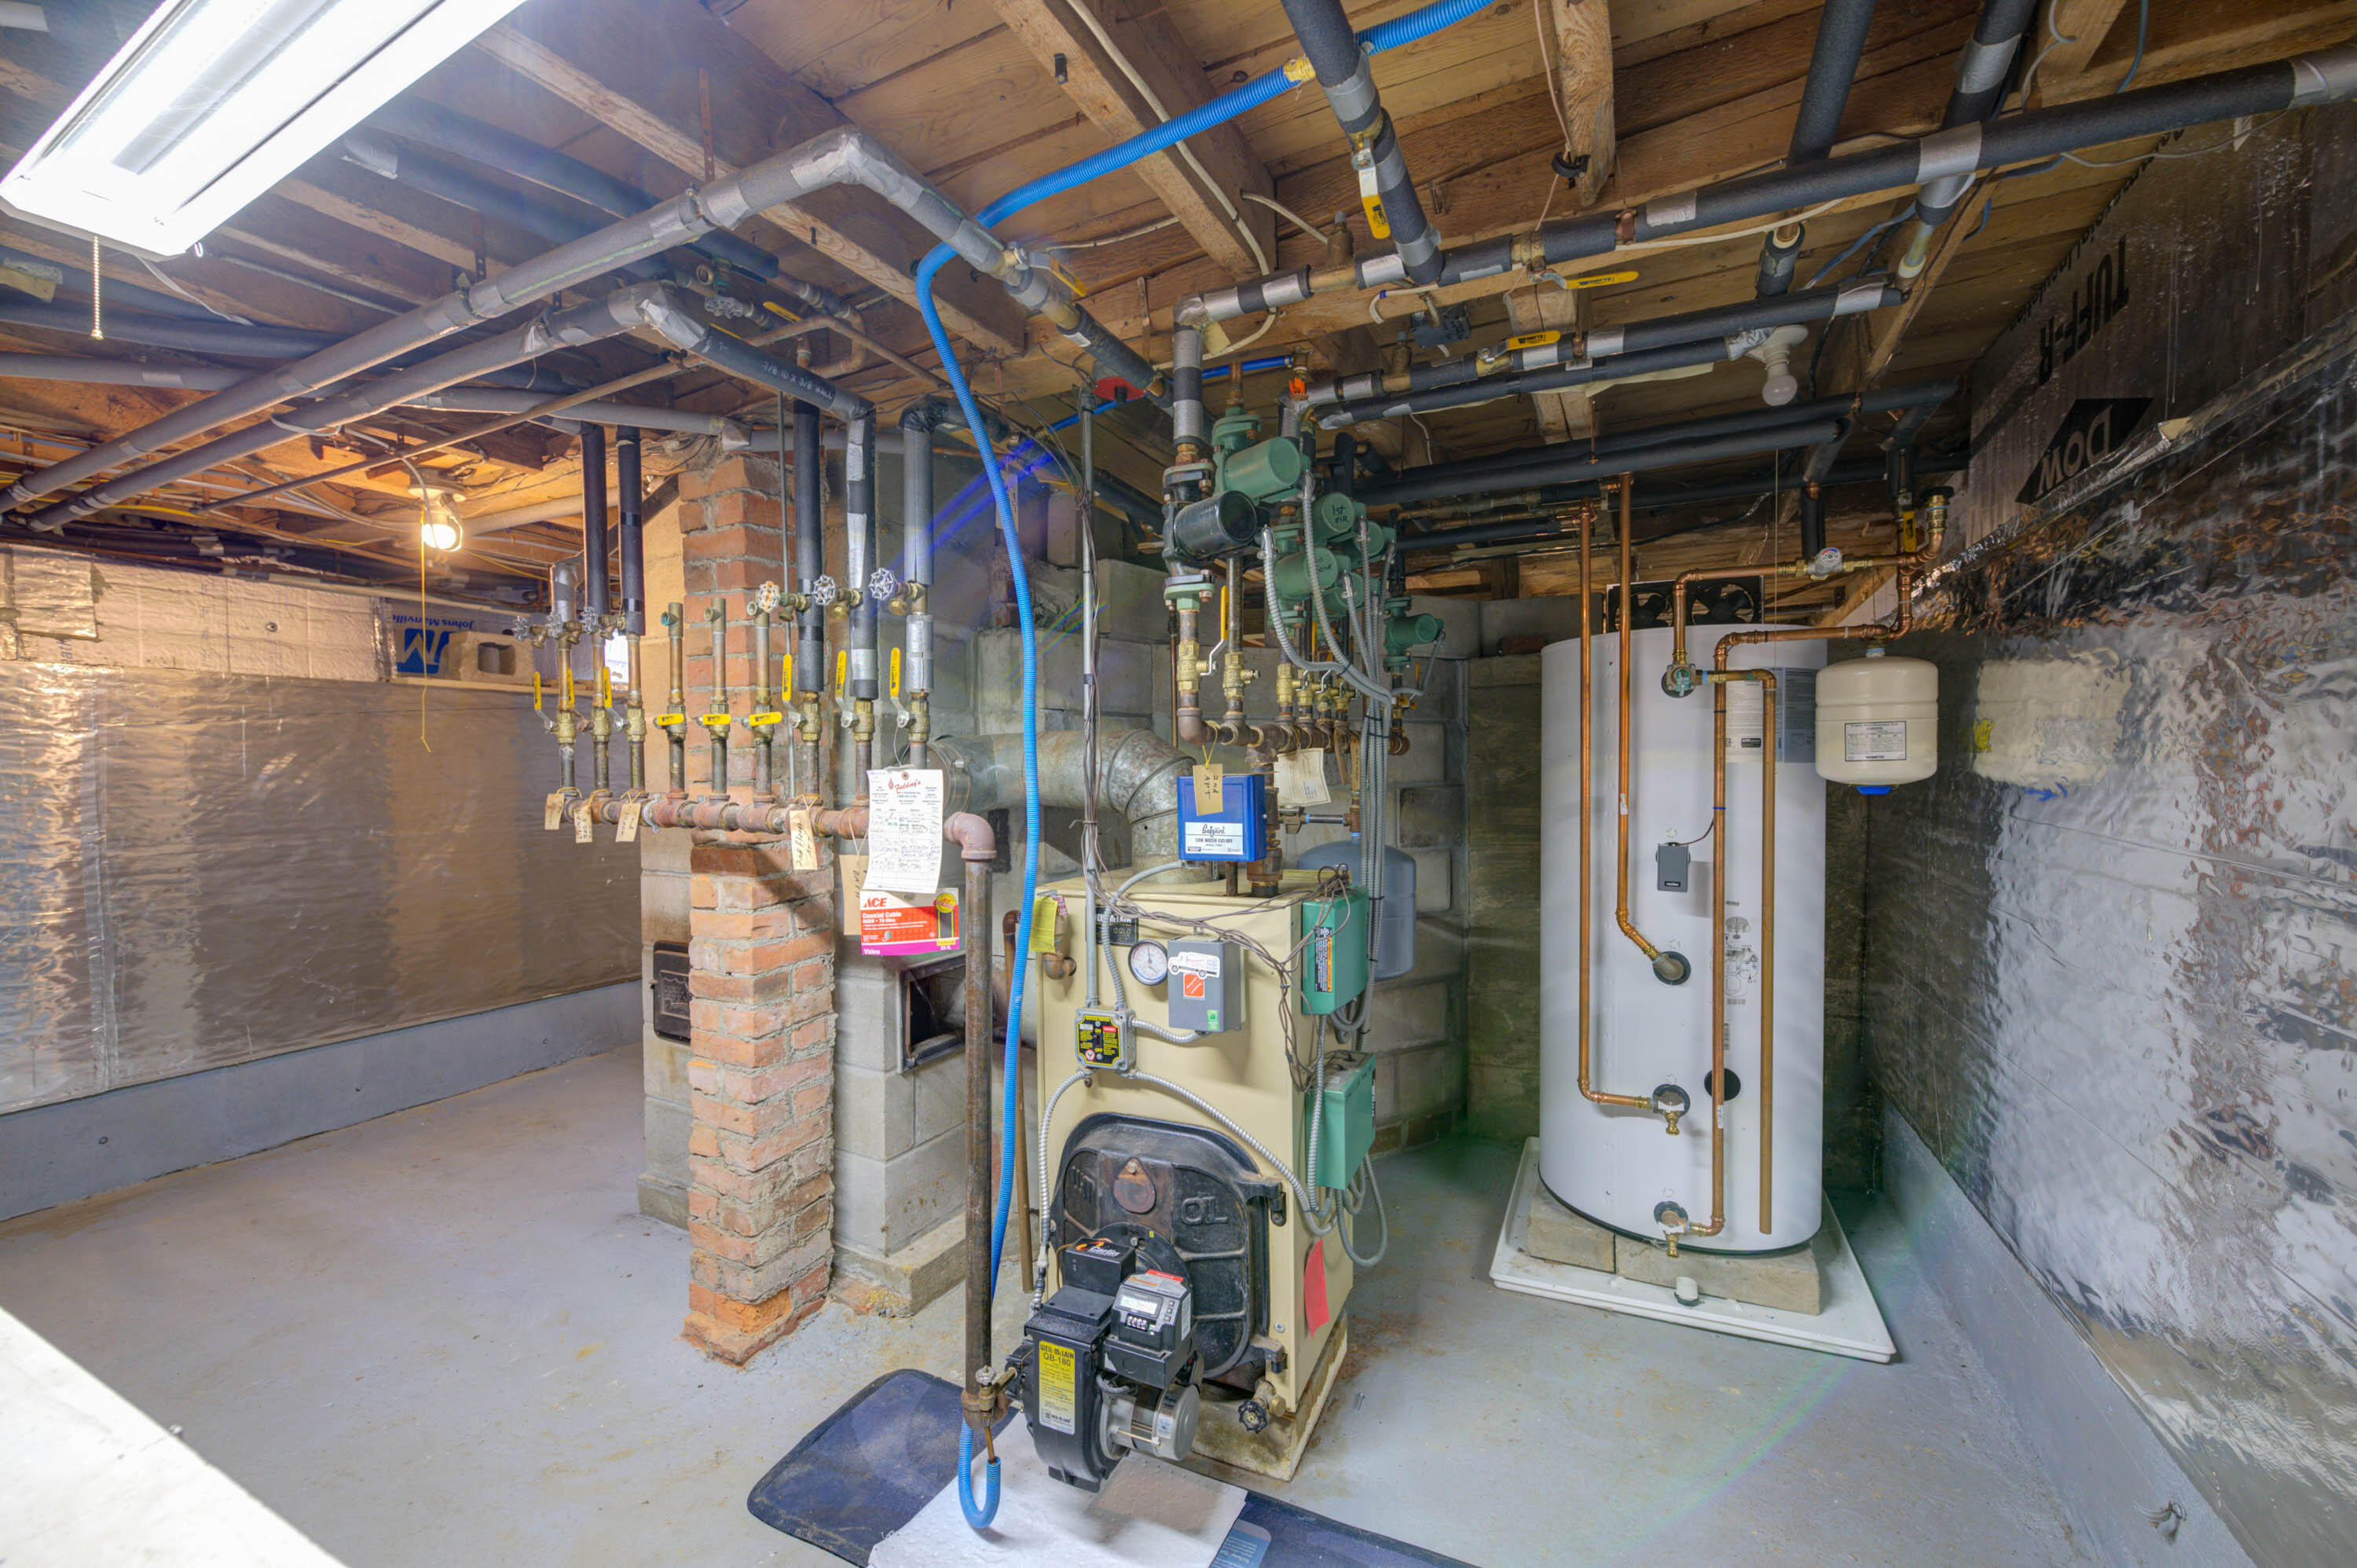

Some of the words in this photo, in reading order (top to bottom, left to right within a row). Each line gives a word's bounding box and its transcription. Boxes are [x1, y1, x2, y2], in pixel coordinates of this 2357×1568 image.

[2039, 236, 2129, 386] TUFF-R
[2035, 405, 2113, 497] DOW
[442, 618, 475, 629] Johns
[863, 898, 887, 908] ACE
[1043, 1353, 1071, 1366] QB-180
